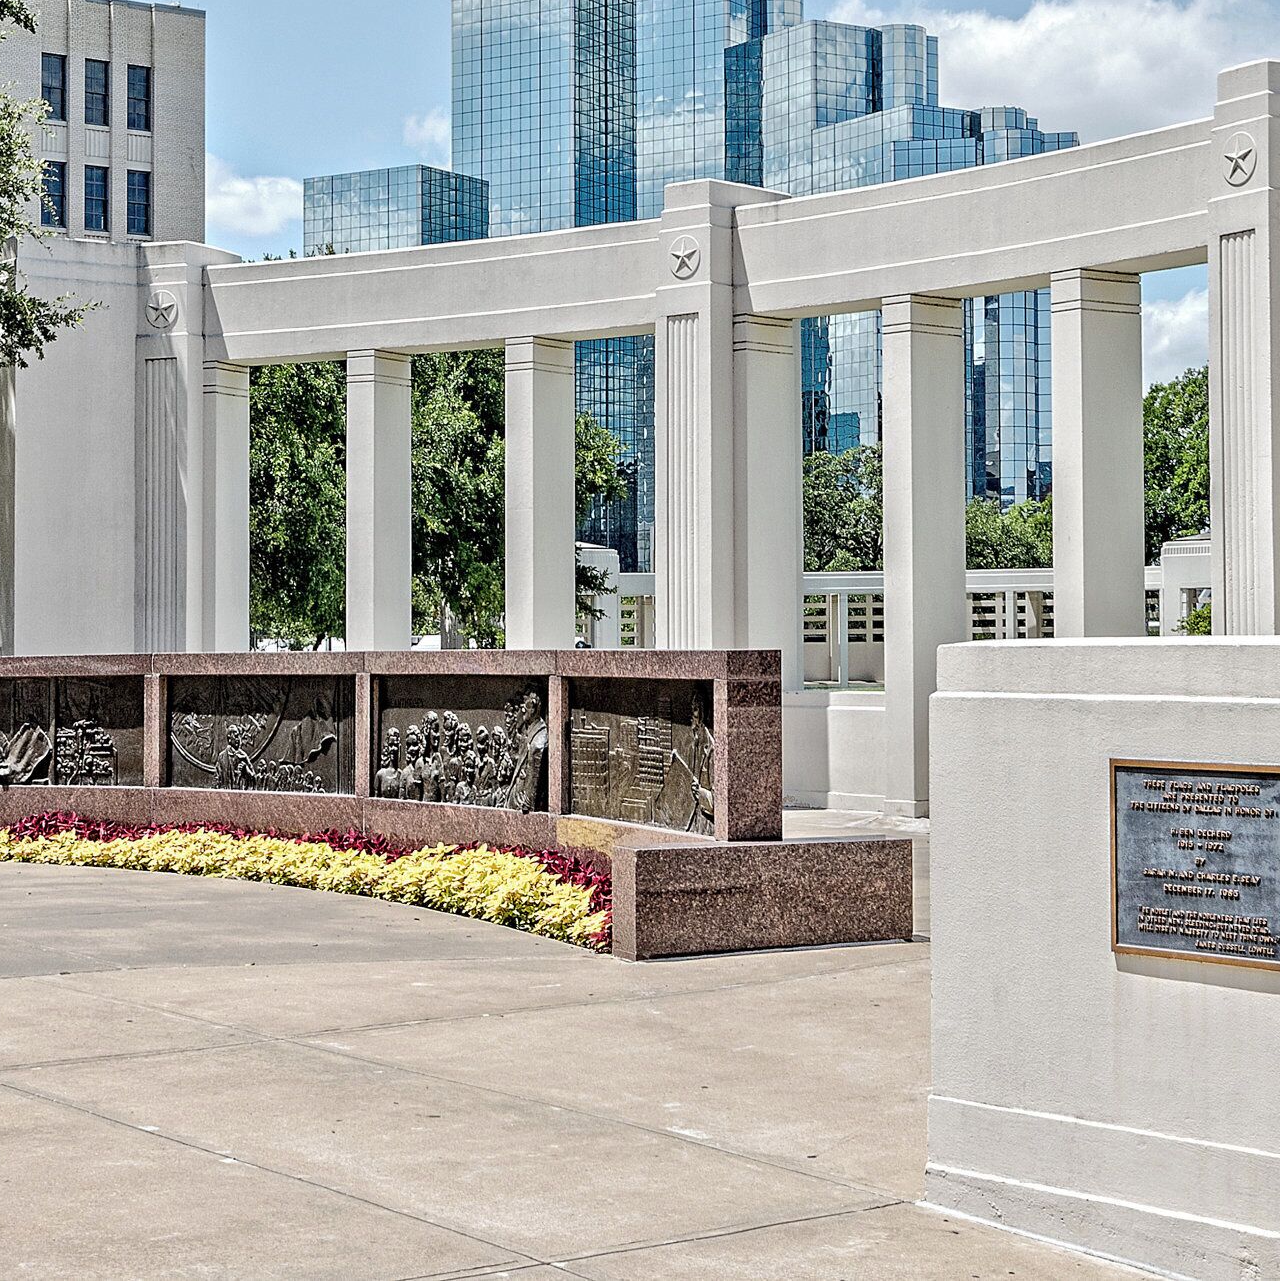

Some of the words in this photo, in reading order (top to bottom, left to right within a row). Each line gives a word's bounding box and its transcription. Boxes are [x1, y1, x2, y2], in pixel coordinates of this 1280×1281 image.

[1143, 780, 1165, 789] THESE
[1170, 781, 1192, 790] FLAGS
[1196, 782, 1212, 792] AND
[1163, 792, 1177, 801] ARE
[1180, 792, 1224, 803] PRESENTED
[1130, 801, 1144, 809] THE
[1146, 802, 1180, 812] CITIZENS
[1194, 804, 1222, 814] DALLAS
[1234, 807, 1261, 817] HONOR
[1196, 872, 1231, 883] CHARLES
[1163, 883, 1202, 895] DECEMBER
